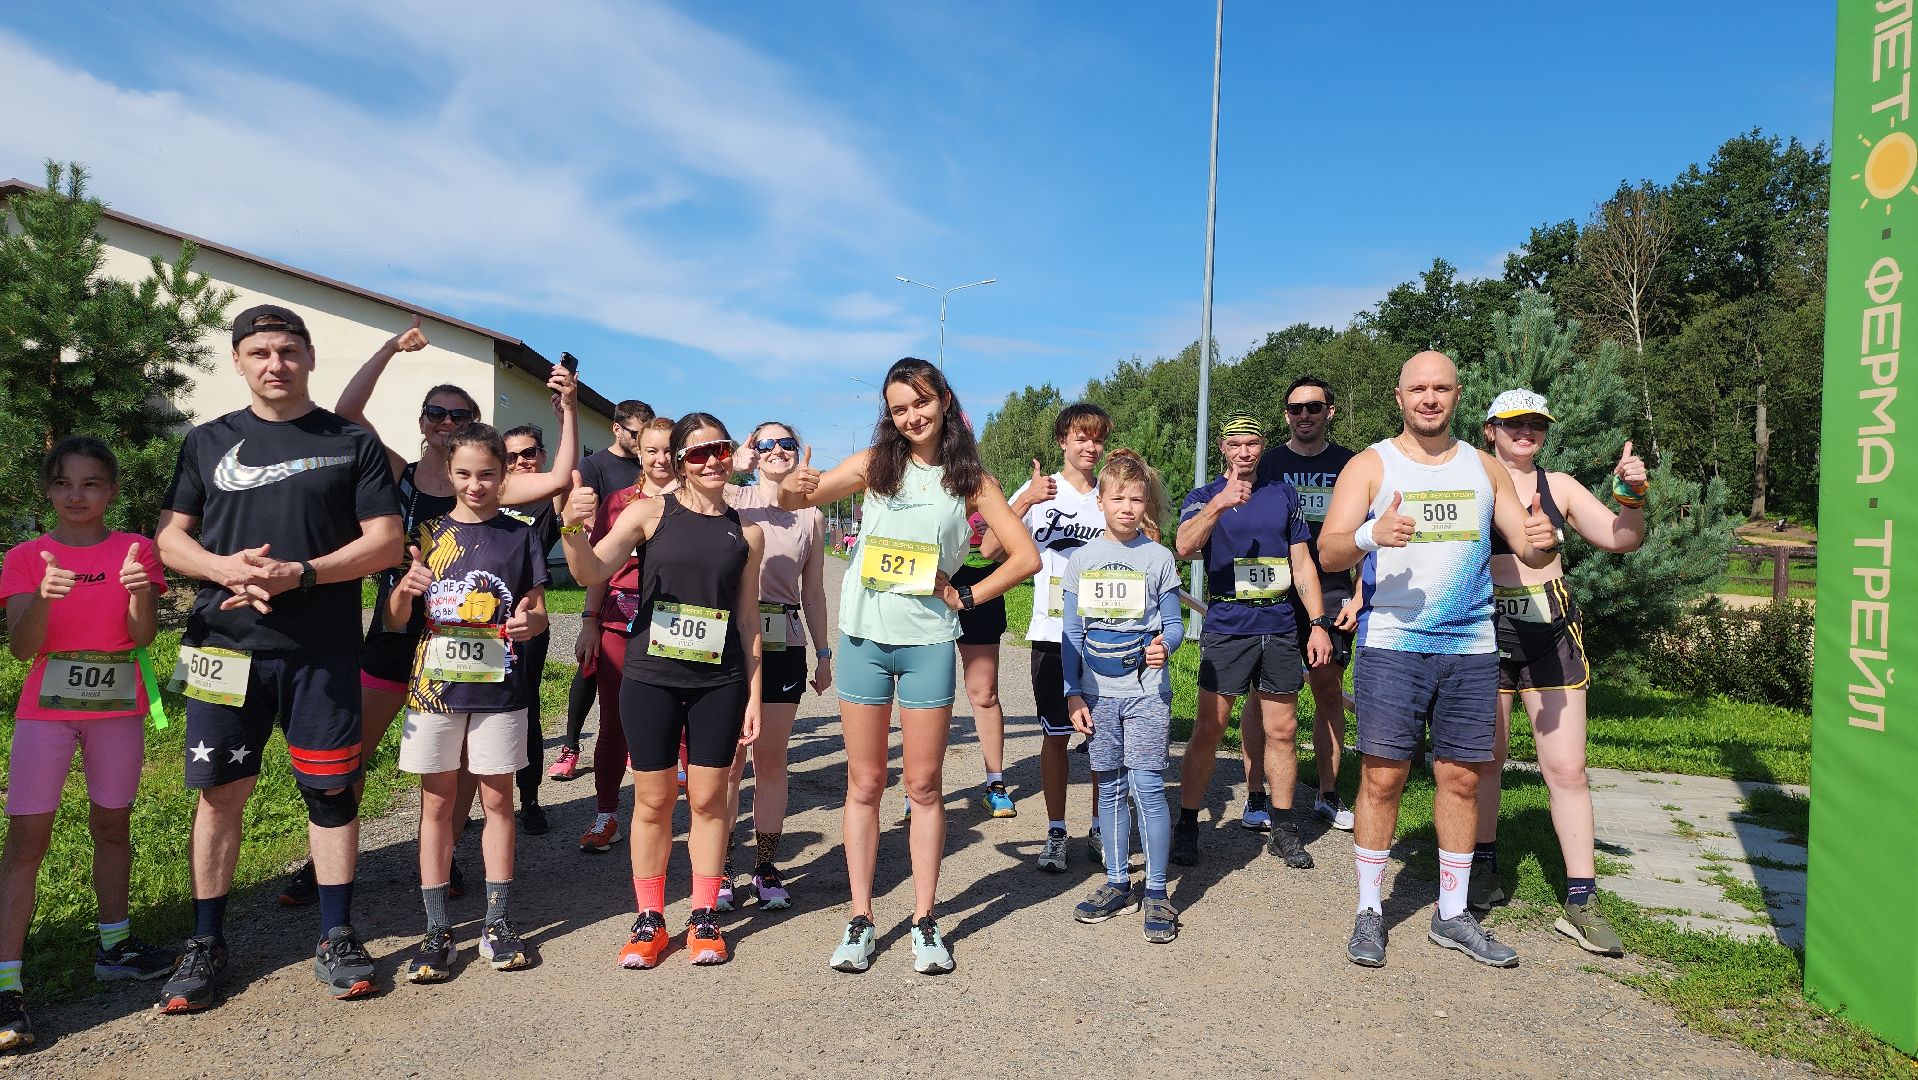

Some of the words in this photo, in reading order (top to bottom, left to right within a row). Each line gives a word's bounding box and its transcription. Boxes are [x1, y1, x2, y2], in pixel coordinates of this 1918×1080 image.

[1856, 257, 1903, 484] ФЕРМА
[1299, 494, 1324, 508] 513
[1423, 503, 1458, 522] 508
[880, 553, 916, 576] 521
[73, 571, 106, 583] FILA
[1249, 567, 1276, 583] 515
[443, 582, 455, 592] НЕ
[456, 583, 466, 594] Я
[1094, 581, 1127, 599] 510
[1495, 597, 1530, 616] 507
[670, 617, 707, 640] 506
[1848, 519, 1895, 732] ТРЕЙЛ
[445, 640, 485, 662] 503
[67, 665, 116, 688] 504
[190, 653, 224, 681] 502
